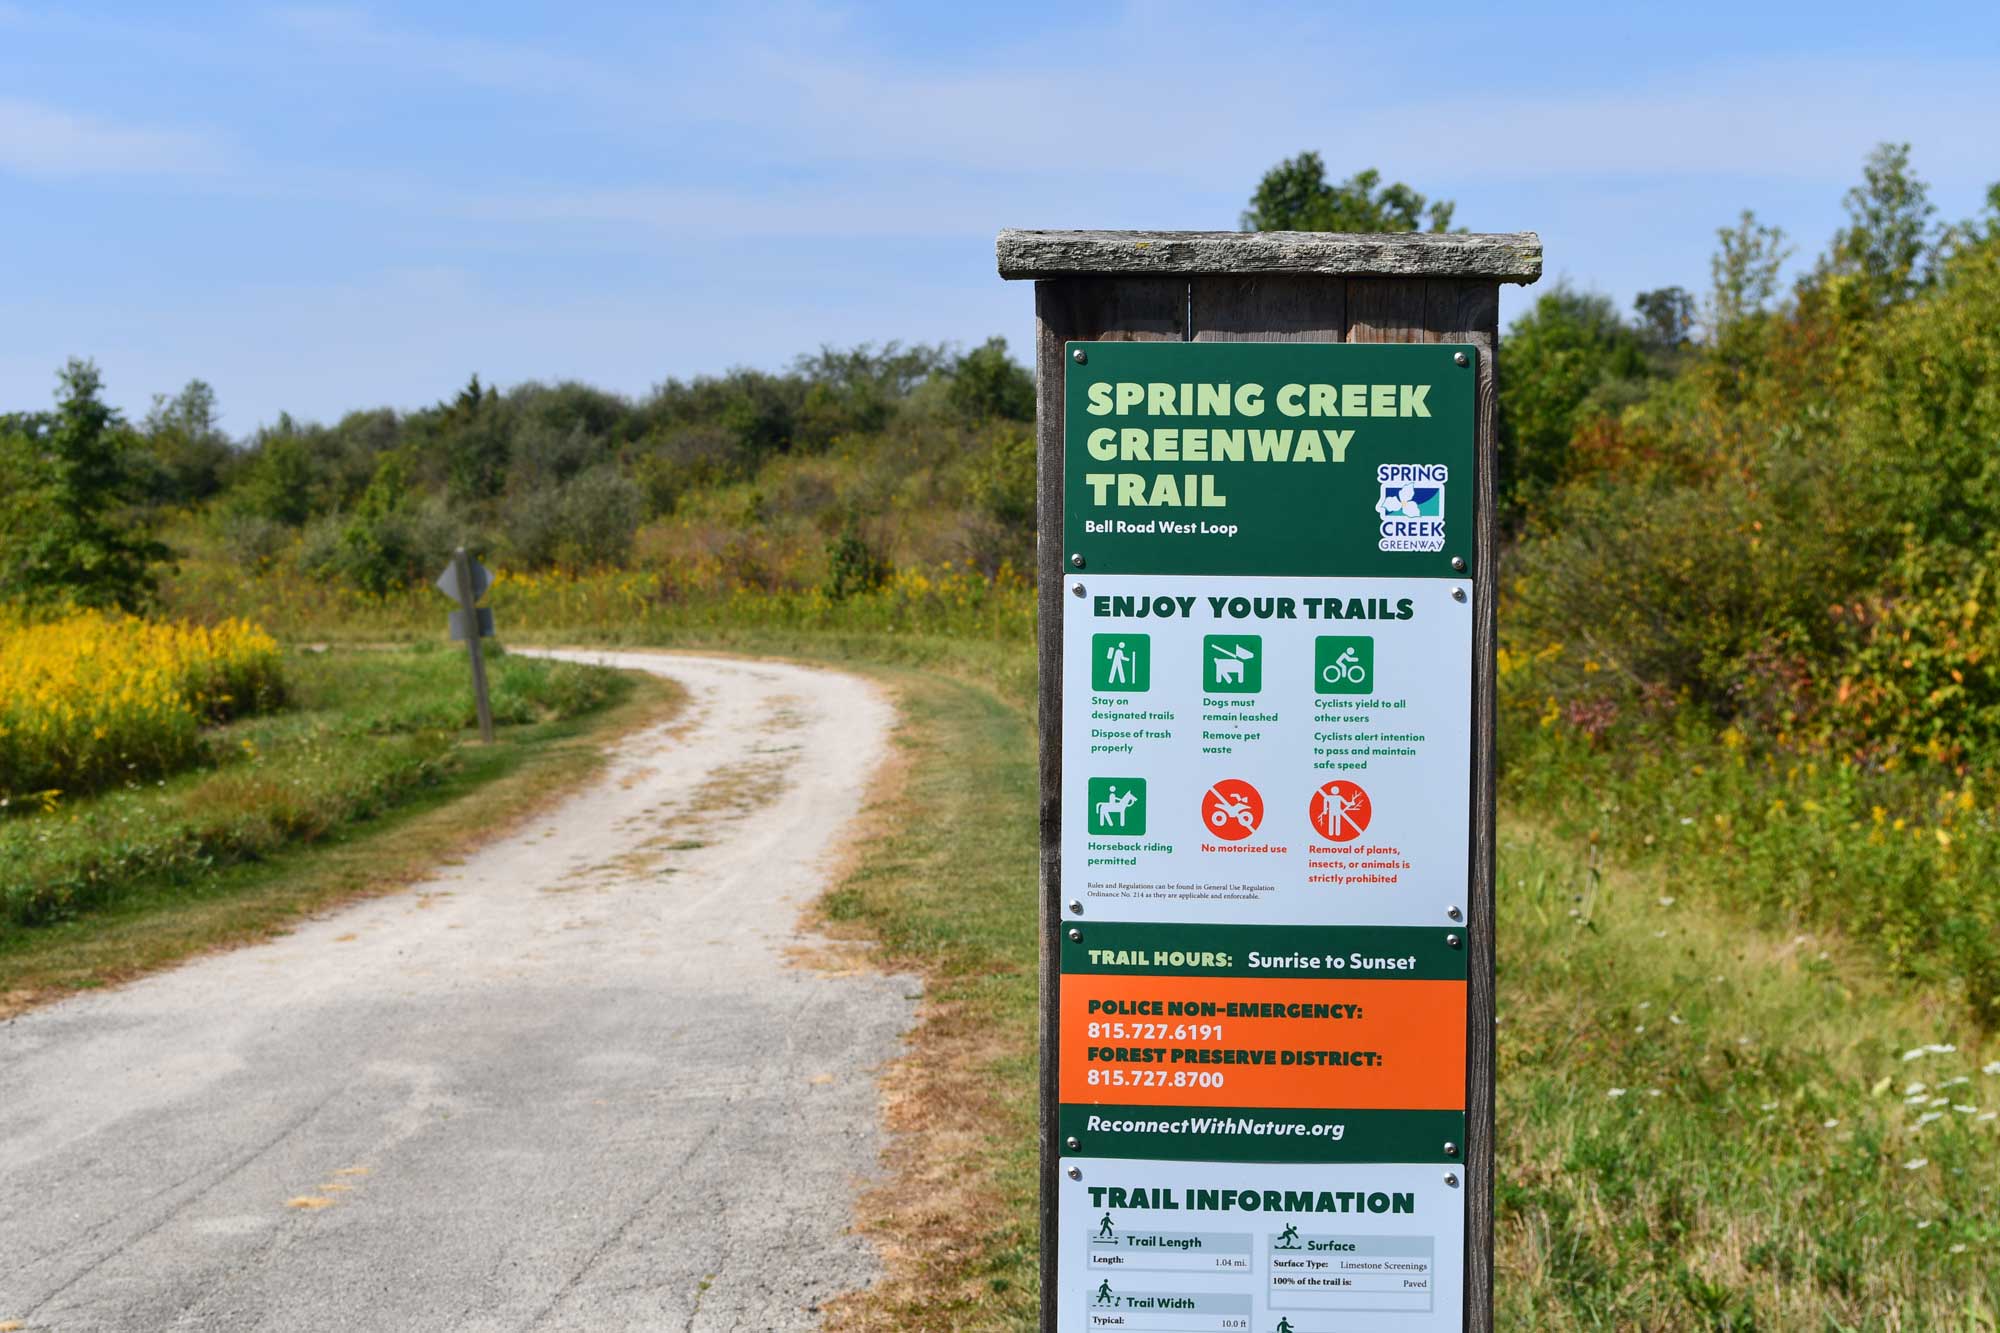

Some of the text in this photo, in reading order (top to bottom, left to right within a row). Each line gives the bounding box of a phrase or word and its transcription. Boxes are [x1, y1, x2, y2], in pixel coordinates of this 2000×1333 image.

[1086, 382, 1432, 418] SPRING CREEK
[1086, 427, 1355, 463] GREENWAY
[1379, 467, 1447, 482] SPRING
[1086, 473, 1226, 508] TRAIL
[1085, 519, 1238, 538] Bell Road West Loop
[1382, 521, 1444, 537] CREEK
[1380, 540, 1444, 550] GREENWAY
[1093, 596, 1414, 621] ENJOY YOUR TRAILS
[1091, 696, 1129, 707] Stay on
[1203, 697, 1255, 709] Dogs must
[1314, 698, 1406, 711] Cyclists yield to all
[1091, 710, 1175, 722] designated trails
[1203, 711, 1278, 722] remain leashed
[1314, 712, 1370, 723] other users
[1091, 728, 1172, 741] Dispose of trash
[1203, 730, 1261, 742] Remove pet
[1314, 731, 1426, 744] Cyclists alert intention
[1091, 742, 1134, 754] properly
[1203, 745, 1232, 754] waste
[1314, 746, 1417, 758] to pass and maintain
[1313, 759, 1368, 772] safe speed
[1088, 841, 1173, 854] Horseback riding
[1201, 843, 1288, 853] No motorized use
[1309, 844, 1401, 857] Removal of plants,
[1088, 856, 1137, 868] permitted
[1308, 859, 1346, 870] insects,
[1362, 859, 1400, 869] animals
[1402, 859, 1411, 869] is
[1308, 872, 1398, 885] strictly prohibited
[1104, 882, 1117, 890] and
[1119, 882, 1153, 891] Regulations
[1176, 882, 1194, 890] found
[1242, 884, 1275, 894] Regulation
[1154, 891, 1166, 900] they
[1179, 891, 1209, 901] applicable
[1088, 949, 1416, 970] TRAIL HOURS: Sunrise to Sunset
[1088, 1000, 1363, 1019] POLICE NON-EMERGENCY:
[1088, 1023, 1223, 1041] 815.727.6191
[1088, 1047, 1383, 1067] FOREST PRESERVE DISTRICT:
[1087, 1070, 1224, 1088] 815.727.8700
[1087, 1116, 1345, 1141] ReconnectWithNature.org
[1088, 1187, 1414, 1214] TRAIL INFORMATION
[1127, 1236, 1202, 1250] Trail Length
[1308, 1240, 1356, 1252] Surface
[1093, 1256, 1247, 1267] Length: 1.04 mi.
[1274, 1259, 1428, 1273] Surface Type: Limestone Screenings
[1273, 1277, 1427, 1288] 100% of the trail is: Paved
[1126, 1298, 1195, 1310] Trail Width
[1093, 1317, 1246, 1329] Typical: 10.0 ft
